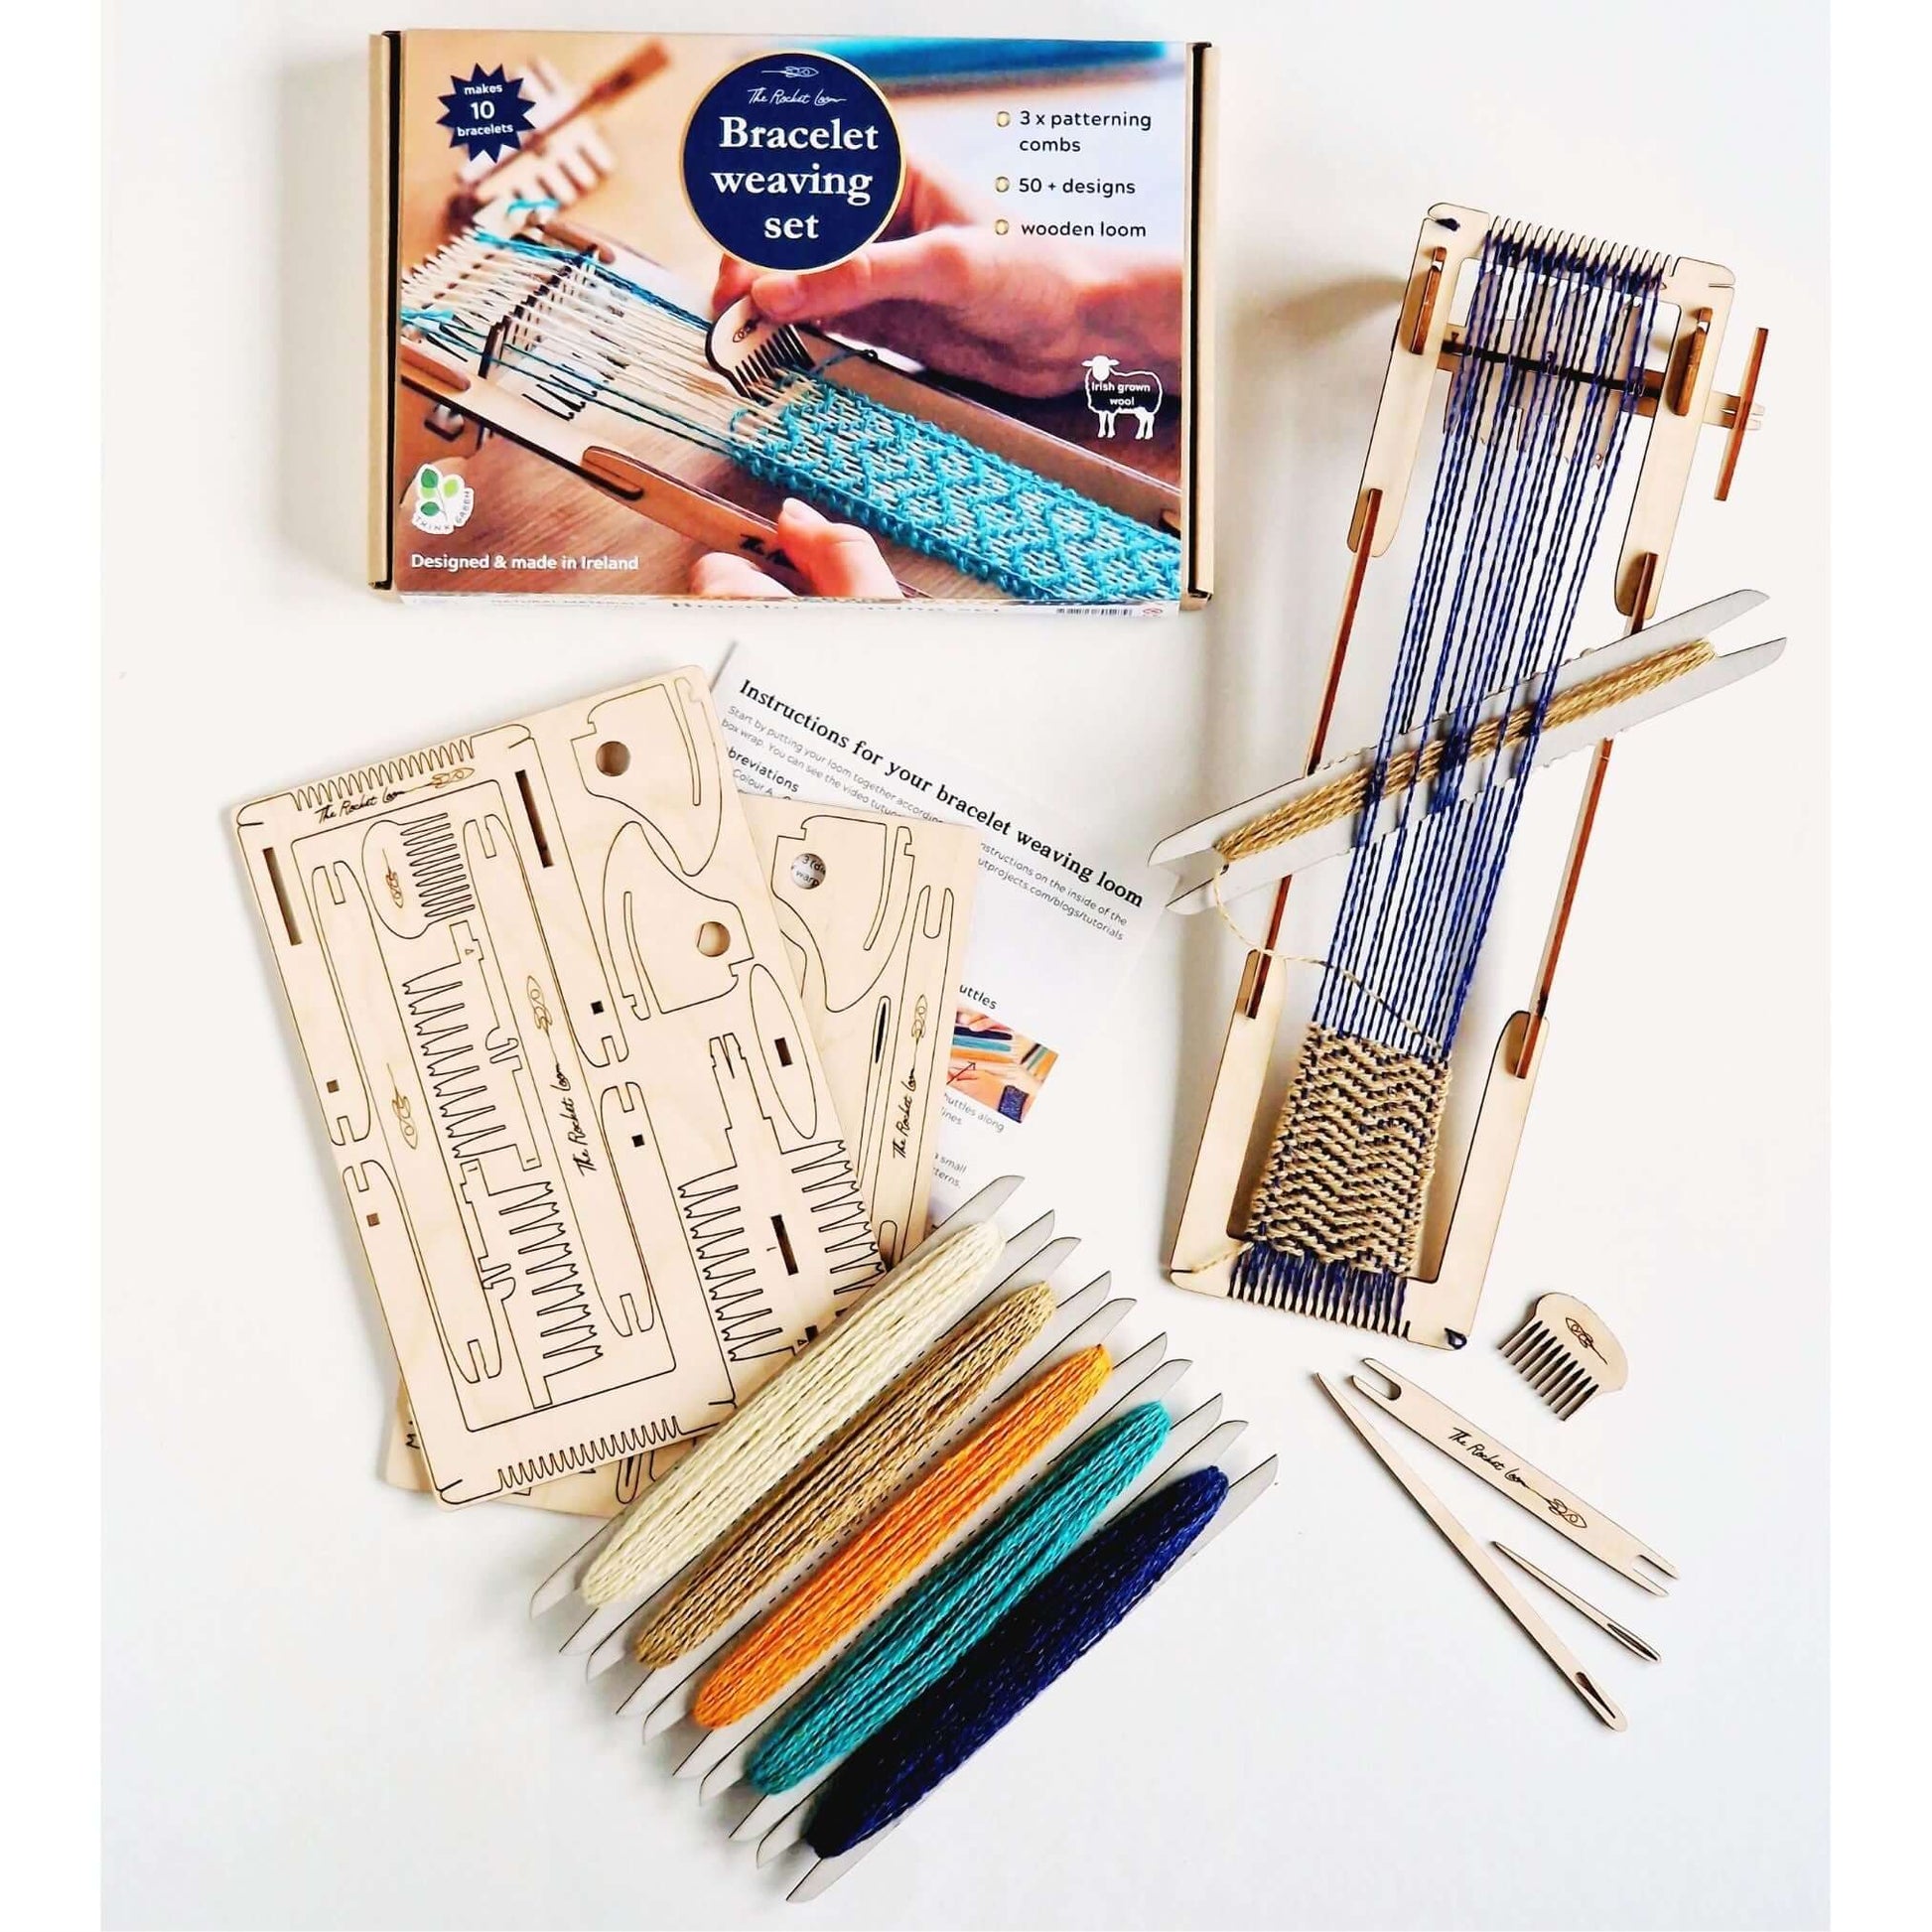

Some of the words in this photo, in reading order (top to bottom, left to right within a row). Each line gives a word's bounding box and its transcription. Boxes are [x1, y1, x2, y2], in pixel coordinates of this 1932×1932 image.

[464, 83, 502, 95] makes
[748, 87, 767, 103] The
[769, 88, 810, 104] Rocket
[471, 100, 495, 119] 10
[1020, 110, 1031, 125] 3
[1035, 114, 1045, 125] x
[1051, 111, 1152, 131] patterning
[457, 123, 514, 137] bracelets
[719, 116, 879, 150] Bracelet
[1020, 137, 1081, 152] combs
[711, 163, 874, 207] weaving
[1019, 178, 1042, 193] 50
[1047, 182, 1056, 191] +
[1062, 178, 1136, 198] designs
[764, 214, 819, 239] set
[1021, 221, 1094, 236] wooden
[1100, 221, 1147, 237] loom
[1091, 381, 1115, 391] Irish
[1117, 384, 1151, 394] grown
[1109, 397, 1135, 406] wool
[411, 554, 490, 572] Designed
[494, 554, 507, 569] &
[511, 554, 557, 569] made
[562, 555, 577, 569] in
[582, 556, 639, 570] Ireland
[722, 719, 738, 733] box
[768, 744, 785, 759] You
[787, 756, 805, 768] can
[806, 764, 823, 778] see
[824, 773, 842, 788] the
[843, 784, 870, 803] video
[727, 746, 799, 792] breviations
[732, 768, 764, 790] Colour
[740, 679, 850, 749] Instructions
[852, 740, 884, 764] for
[885, 761, 933, 791] your
[936, 784, 1012, 835] bracelet
[1017, 830, 1094, 884] weaving
[1096, 871, 1144, 908] loom
[314, 801, 337, 825] The
[339, 794, 378, 818] Rocket
[729, 706, 753, 724] Start
[755, 720, 767, 732] by
[767, 728, 803, 754] putting
[804, 749, 826, 762] your
[827, 759, 852, 777] loom
[853, 774, 897, 801] together
[1035, 872, 1048, 885] on
[1049, 879, 1066, 894] the
[1067, 888, 1096, 910] inside
[1098, 905, 1111, 916] of
[1111, 911, 1128, 926] the
[559, 1097, 589, 1146] Rocket
[896, 1095, 912, 1137] Rocket
[977, 1112, 1005, 1134] along
[893, 1137, 906, 1159] The
[572, 1149, 598, 1177] The
[940, 1156, 967, 1173] small
[1449, 1427, 1471, 1447] The
[1466, 1444, 1506, 1470] Rocket
